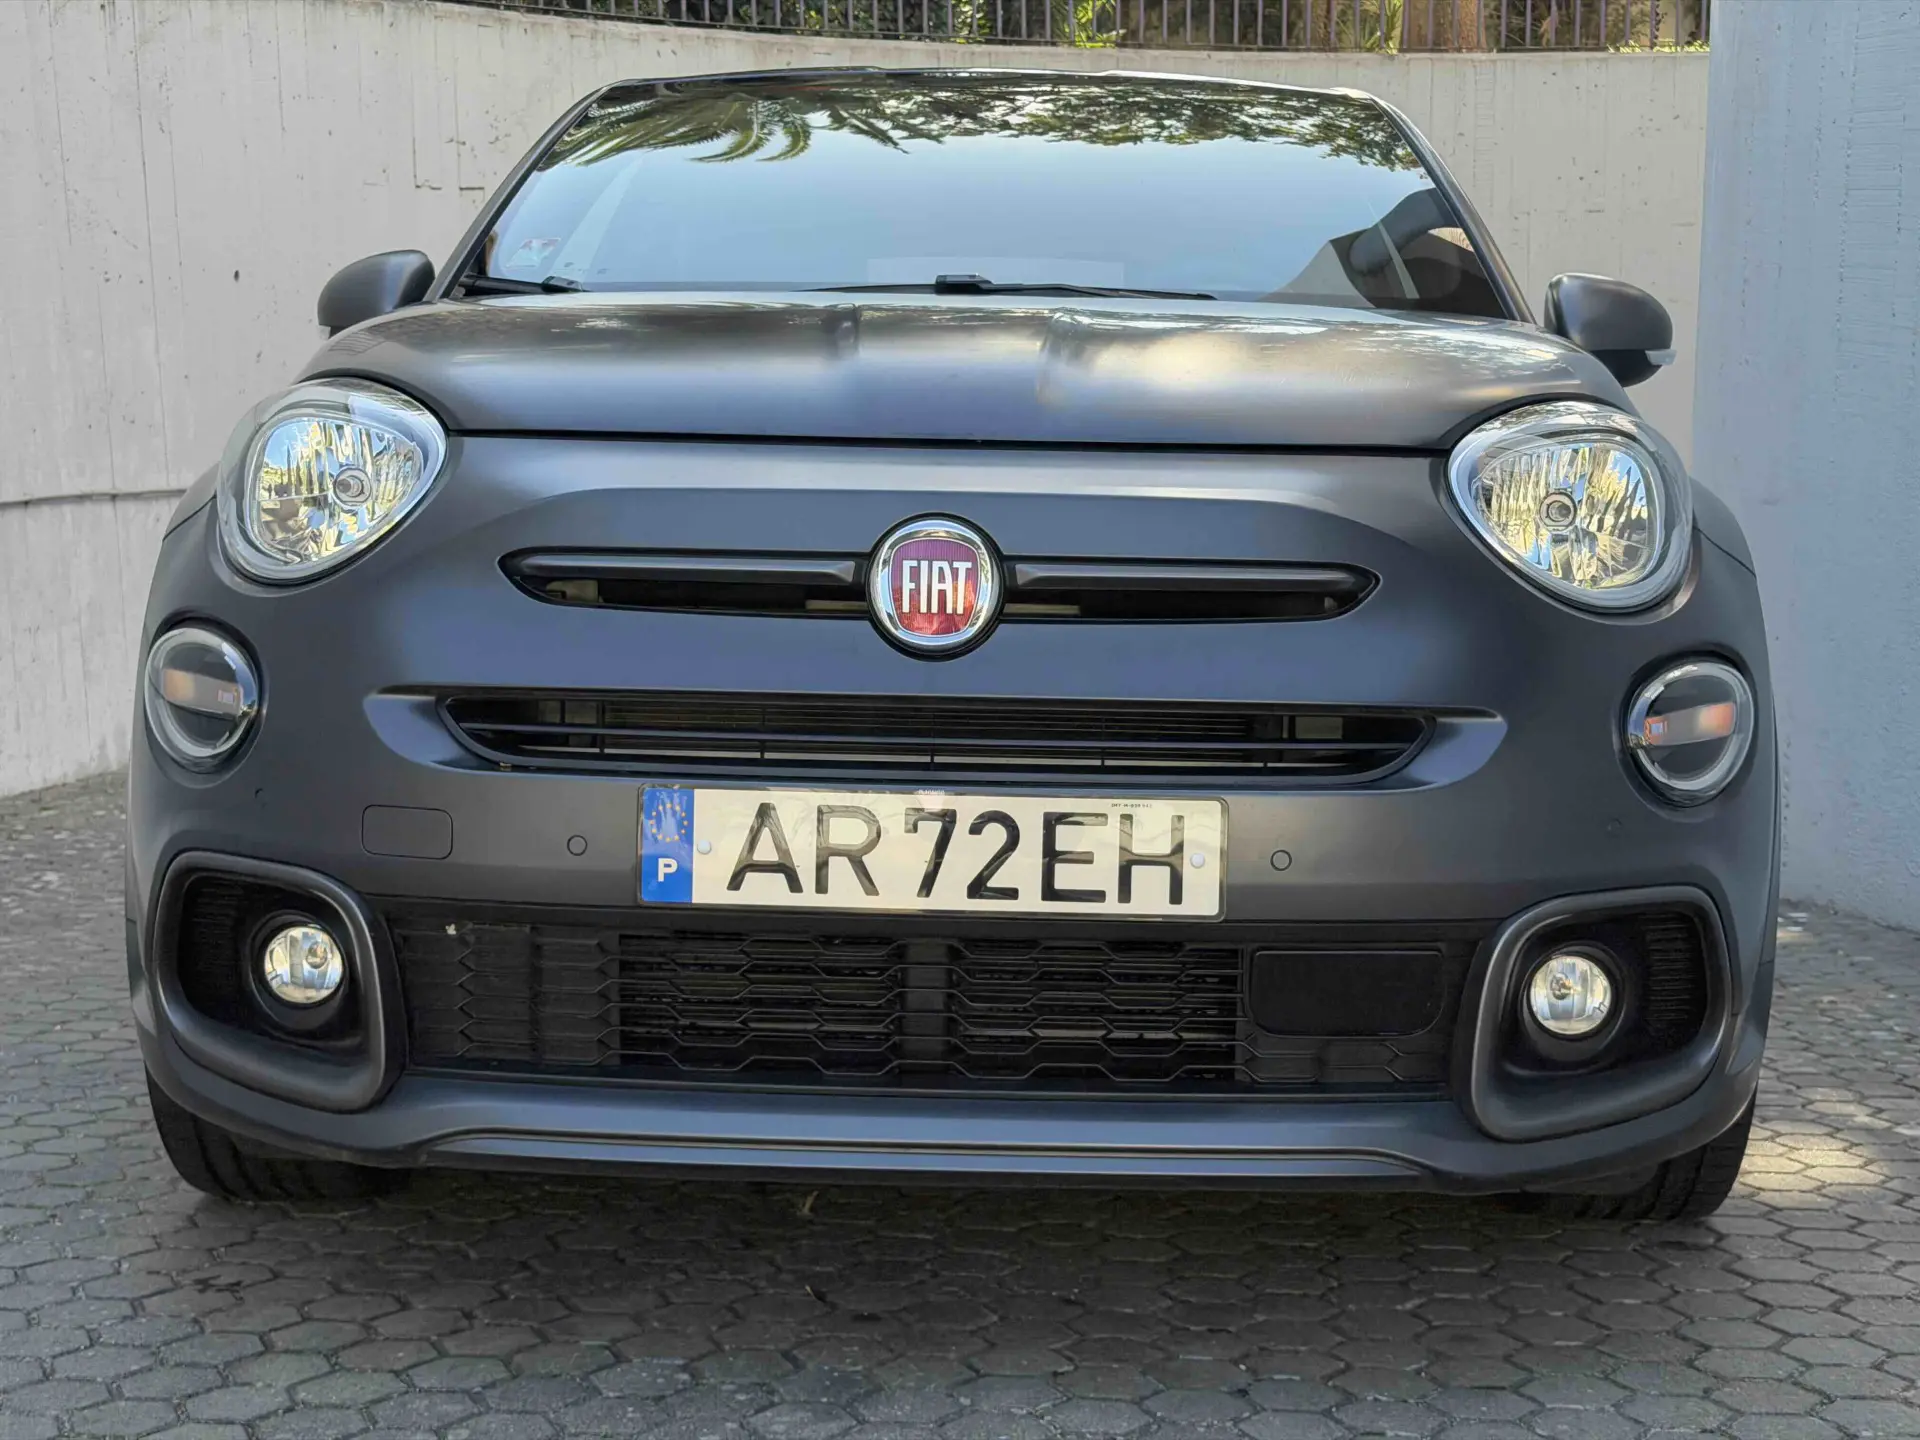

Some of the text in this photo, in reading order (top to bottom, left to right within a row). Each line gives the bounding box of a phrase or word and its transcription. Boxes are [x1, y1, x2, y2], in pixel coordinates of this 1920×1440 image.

[902, 560, 972, 614] FIAT
[657, 857, 678, 882] P
[726, 802, 1184, 905] AR 72 EH
